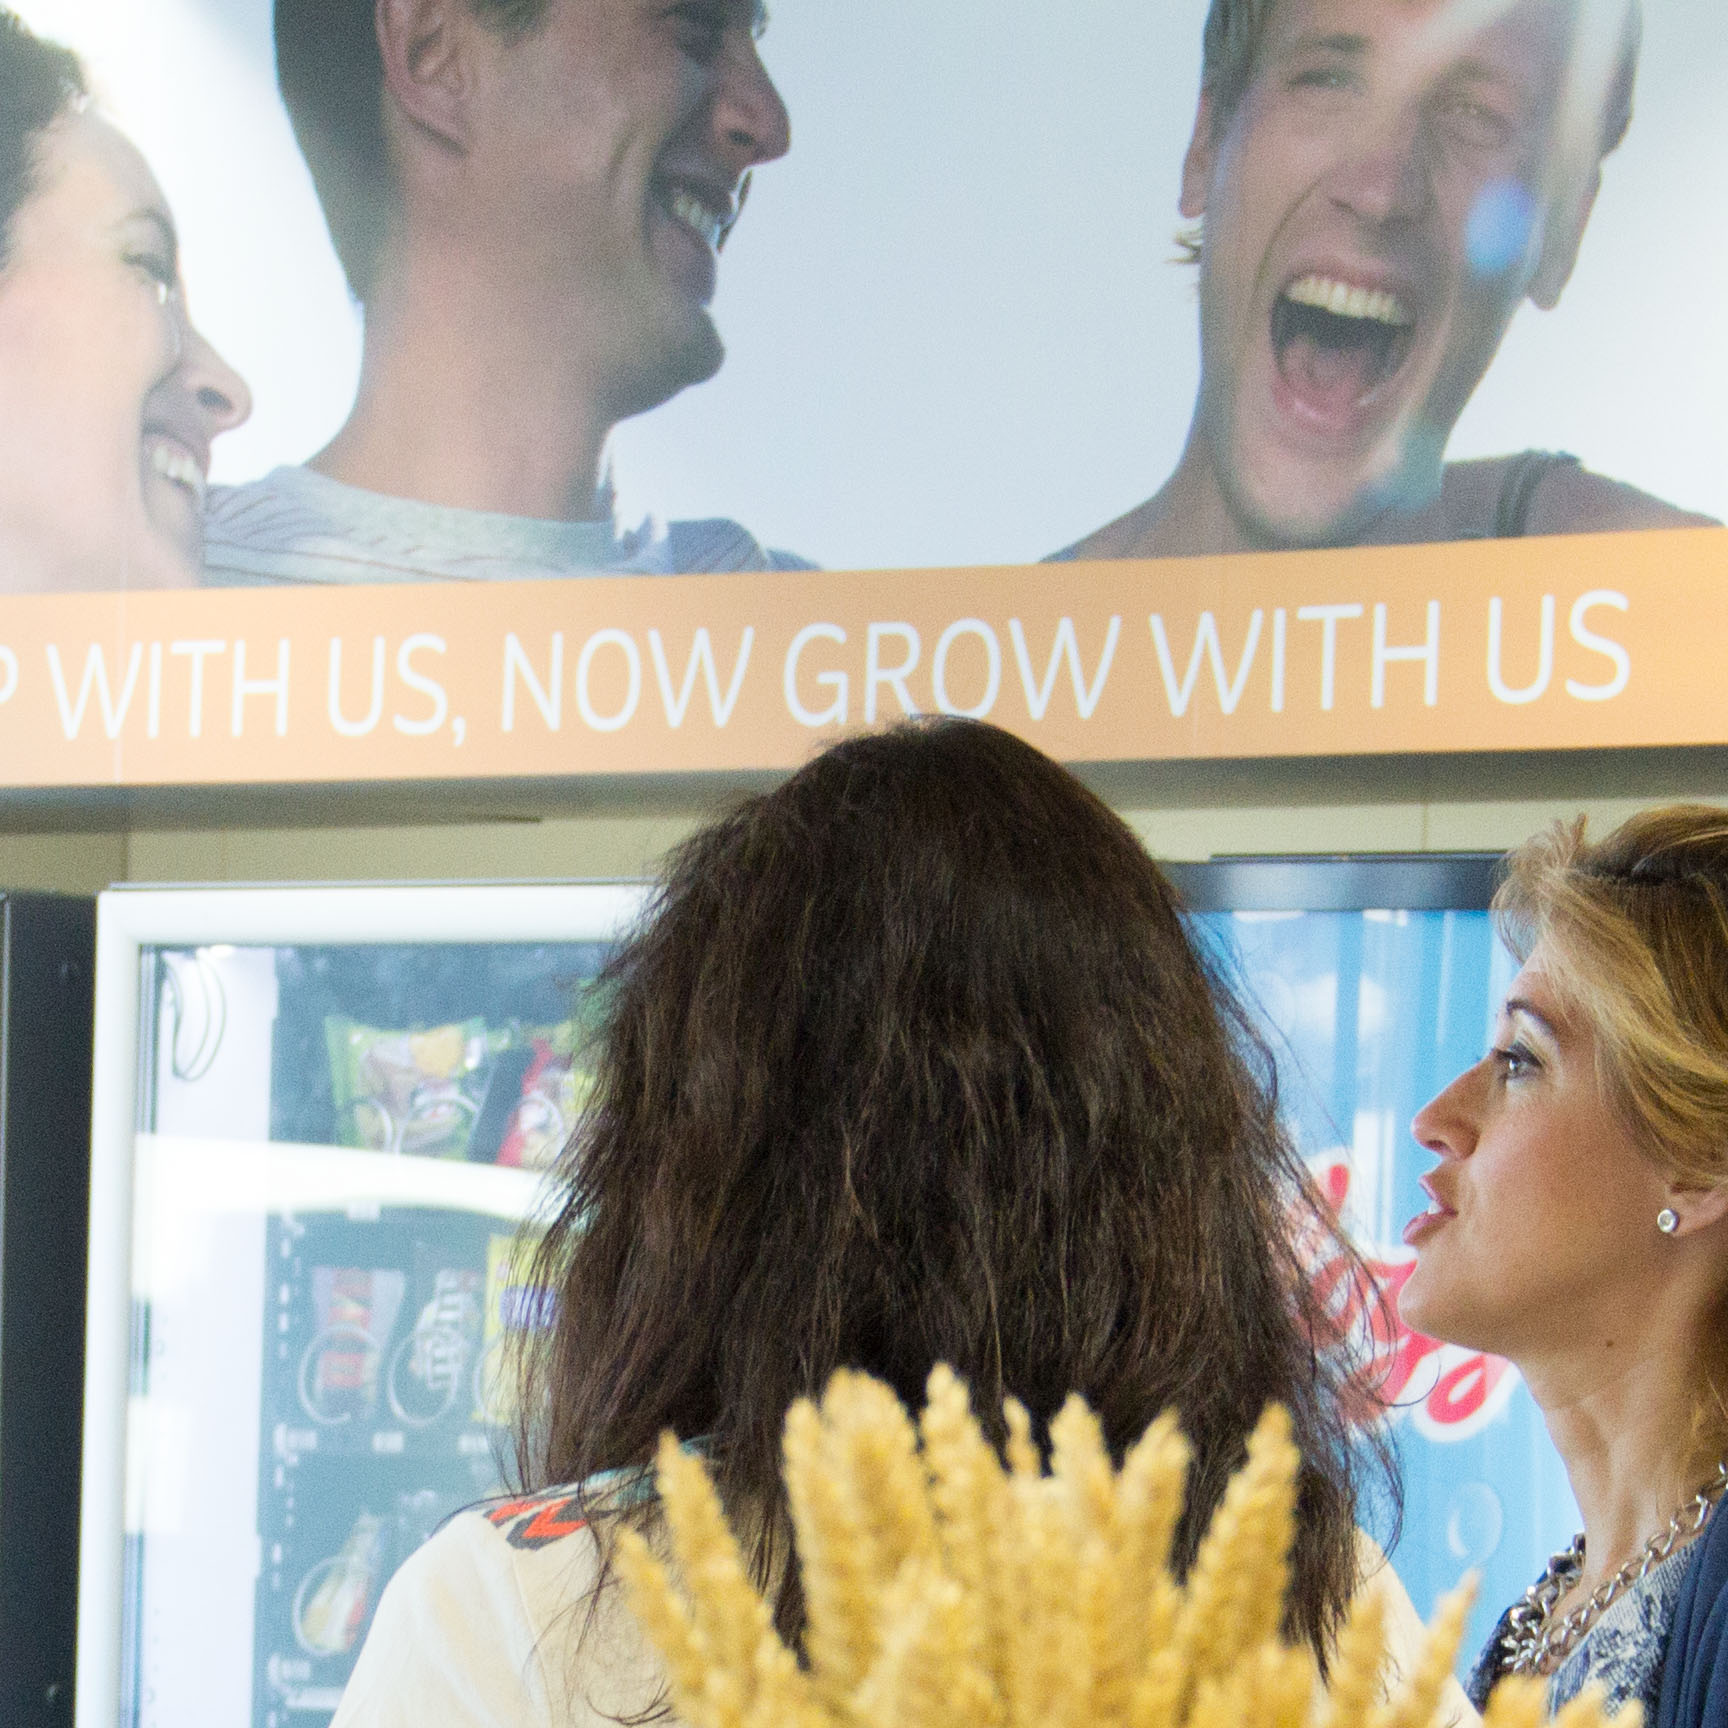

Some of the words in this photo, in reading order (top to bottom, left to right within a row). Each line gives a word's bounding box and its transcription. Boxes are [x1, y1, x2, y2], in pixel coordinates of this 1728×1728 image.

[45, 637, 292, 742] WITH
[326, 632, 468, 748] US,
[500, 626, 755, 733] NOW
[782, 614, 1123, 728] GROW
[1148, 598, 1441, 718] WITH
[1486, 588, 1632, 705] US
